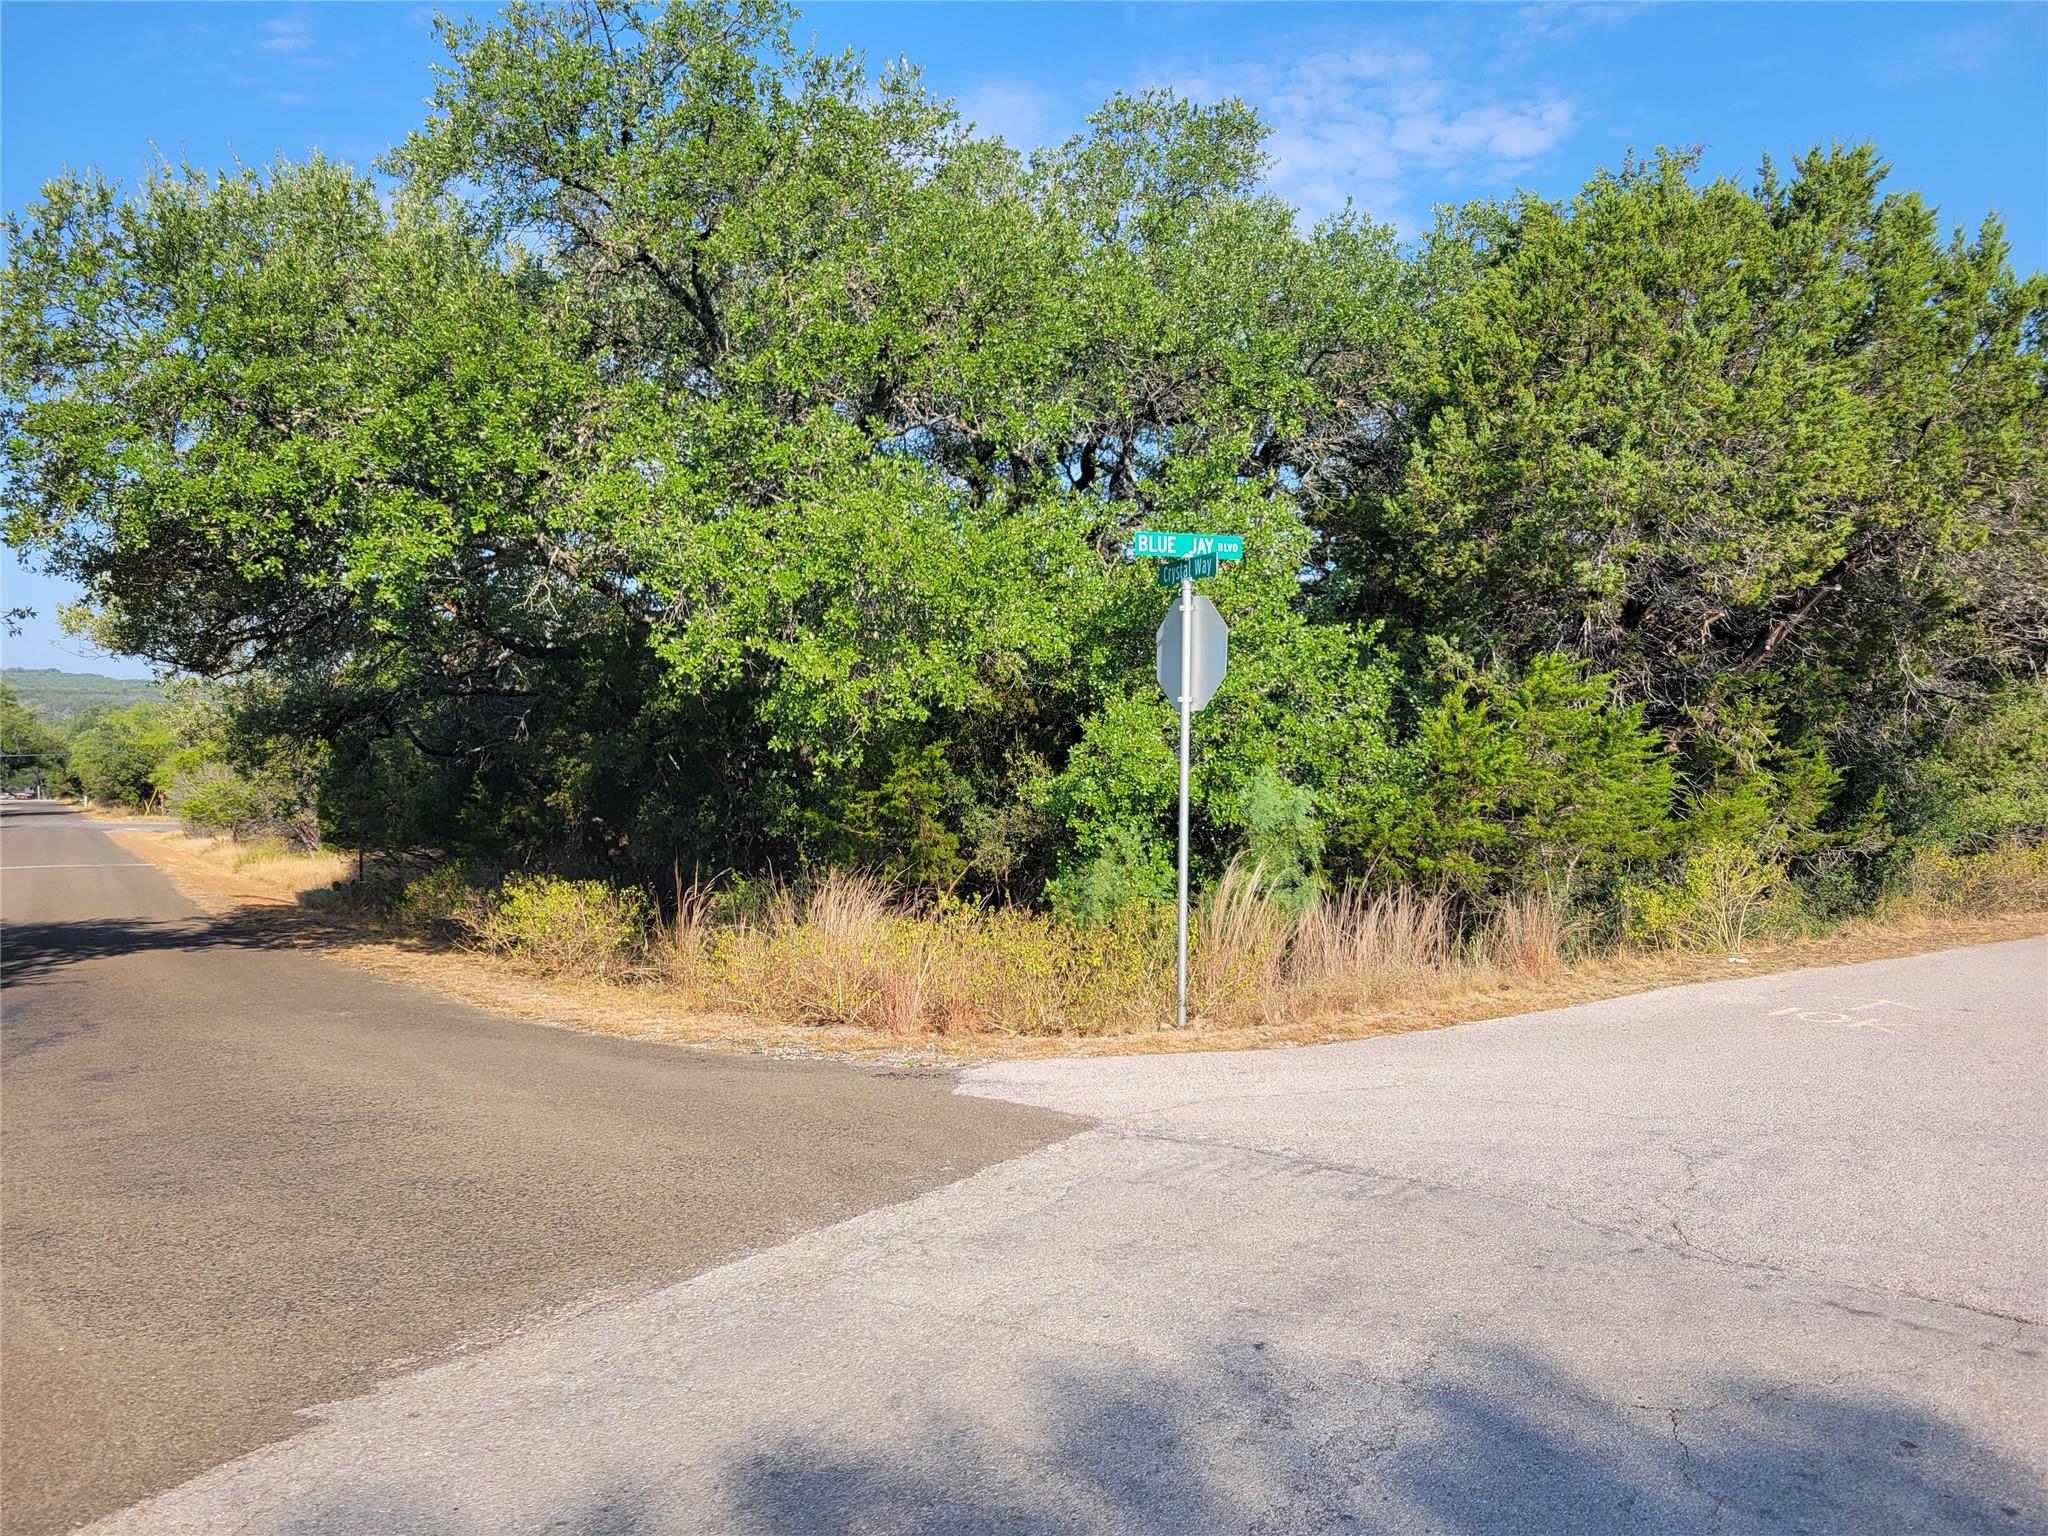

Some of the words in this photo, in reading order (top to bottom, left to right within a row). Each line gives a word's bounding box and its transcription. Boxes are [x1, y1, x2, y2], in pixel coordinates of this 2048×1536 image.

[1138, 535, 1177, 554] BLUE
[1188, 537, 1215, 555] JAY
[1217, 542, 1238, 553] BLVD
[1163, 559, 1191, 584] Crystal
[1194, 558, 1212, 576] Way
